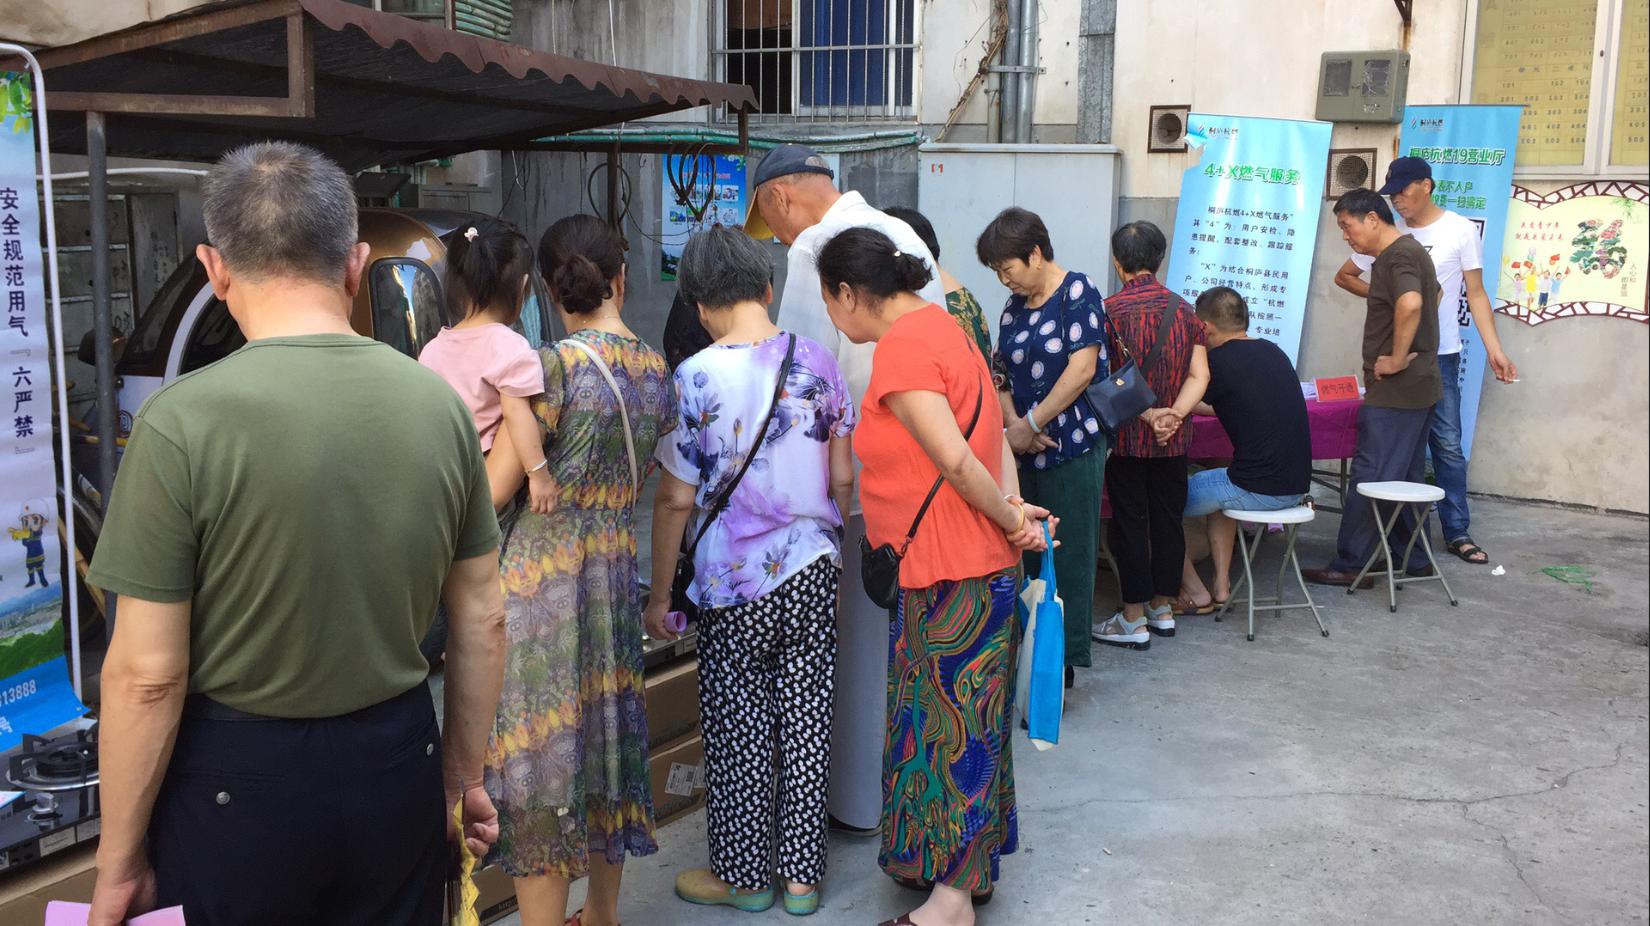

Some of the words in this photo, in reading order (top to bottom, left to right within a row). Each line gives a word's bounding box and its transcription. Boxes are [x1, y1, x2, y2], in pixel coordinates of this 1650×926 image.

[1204, 163, 1300, 185] 4+X燃气服务
[0, 679, 37, 707] 13888
